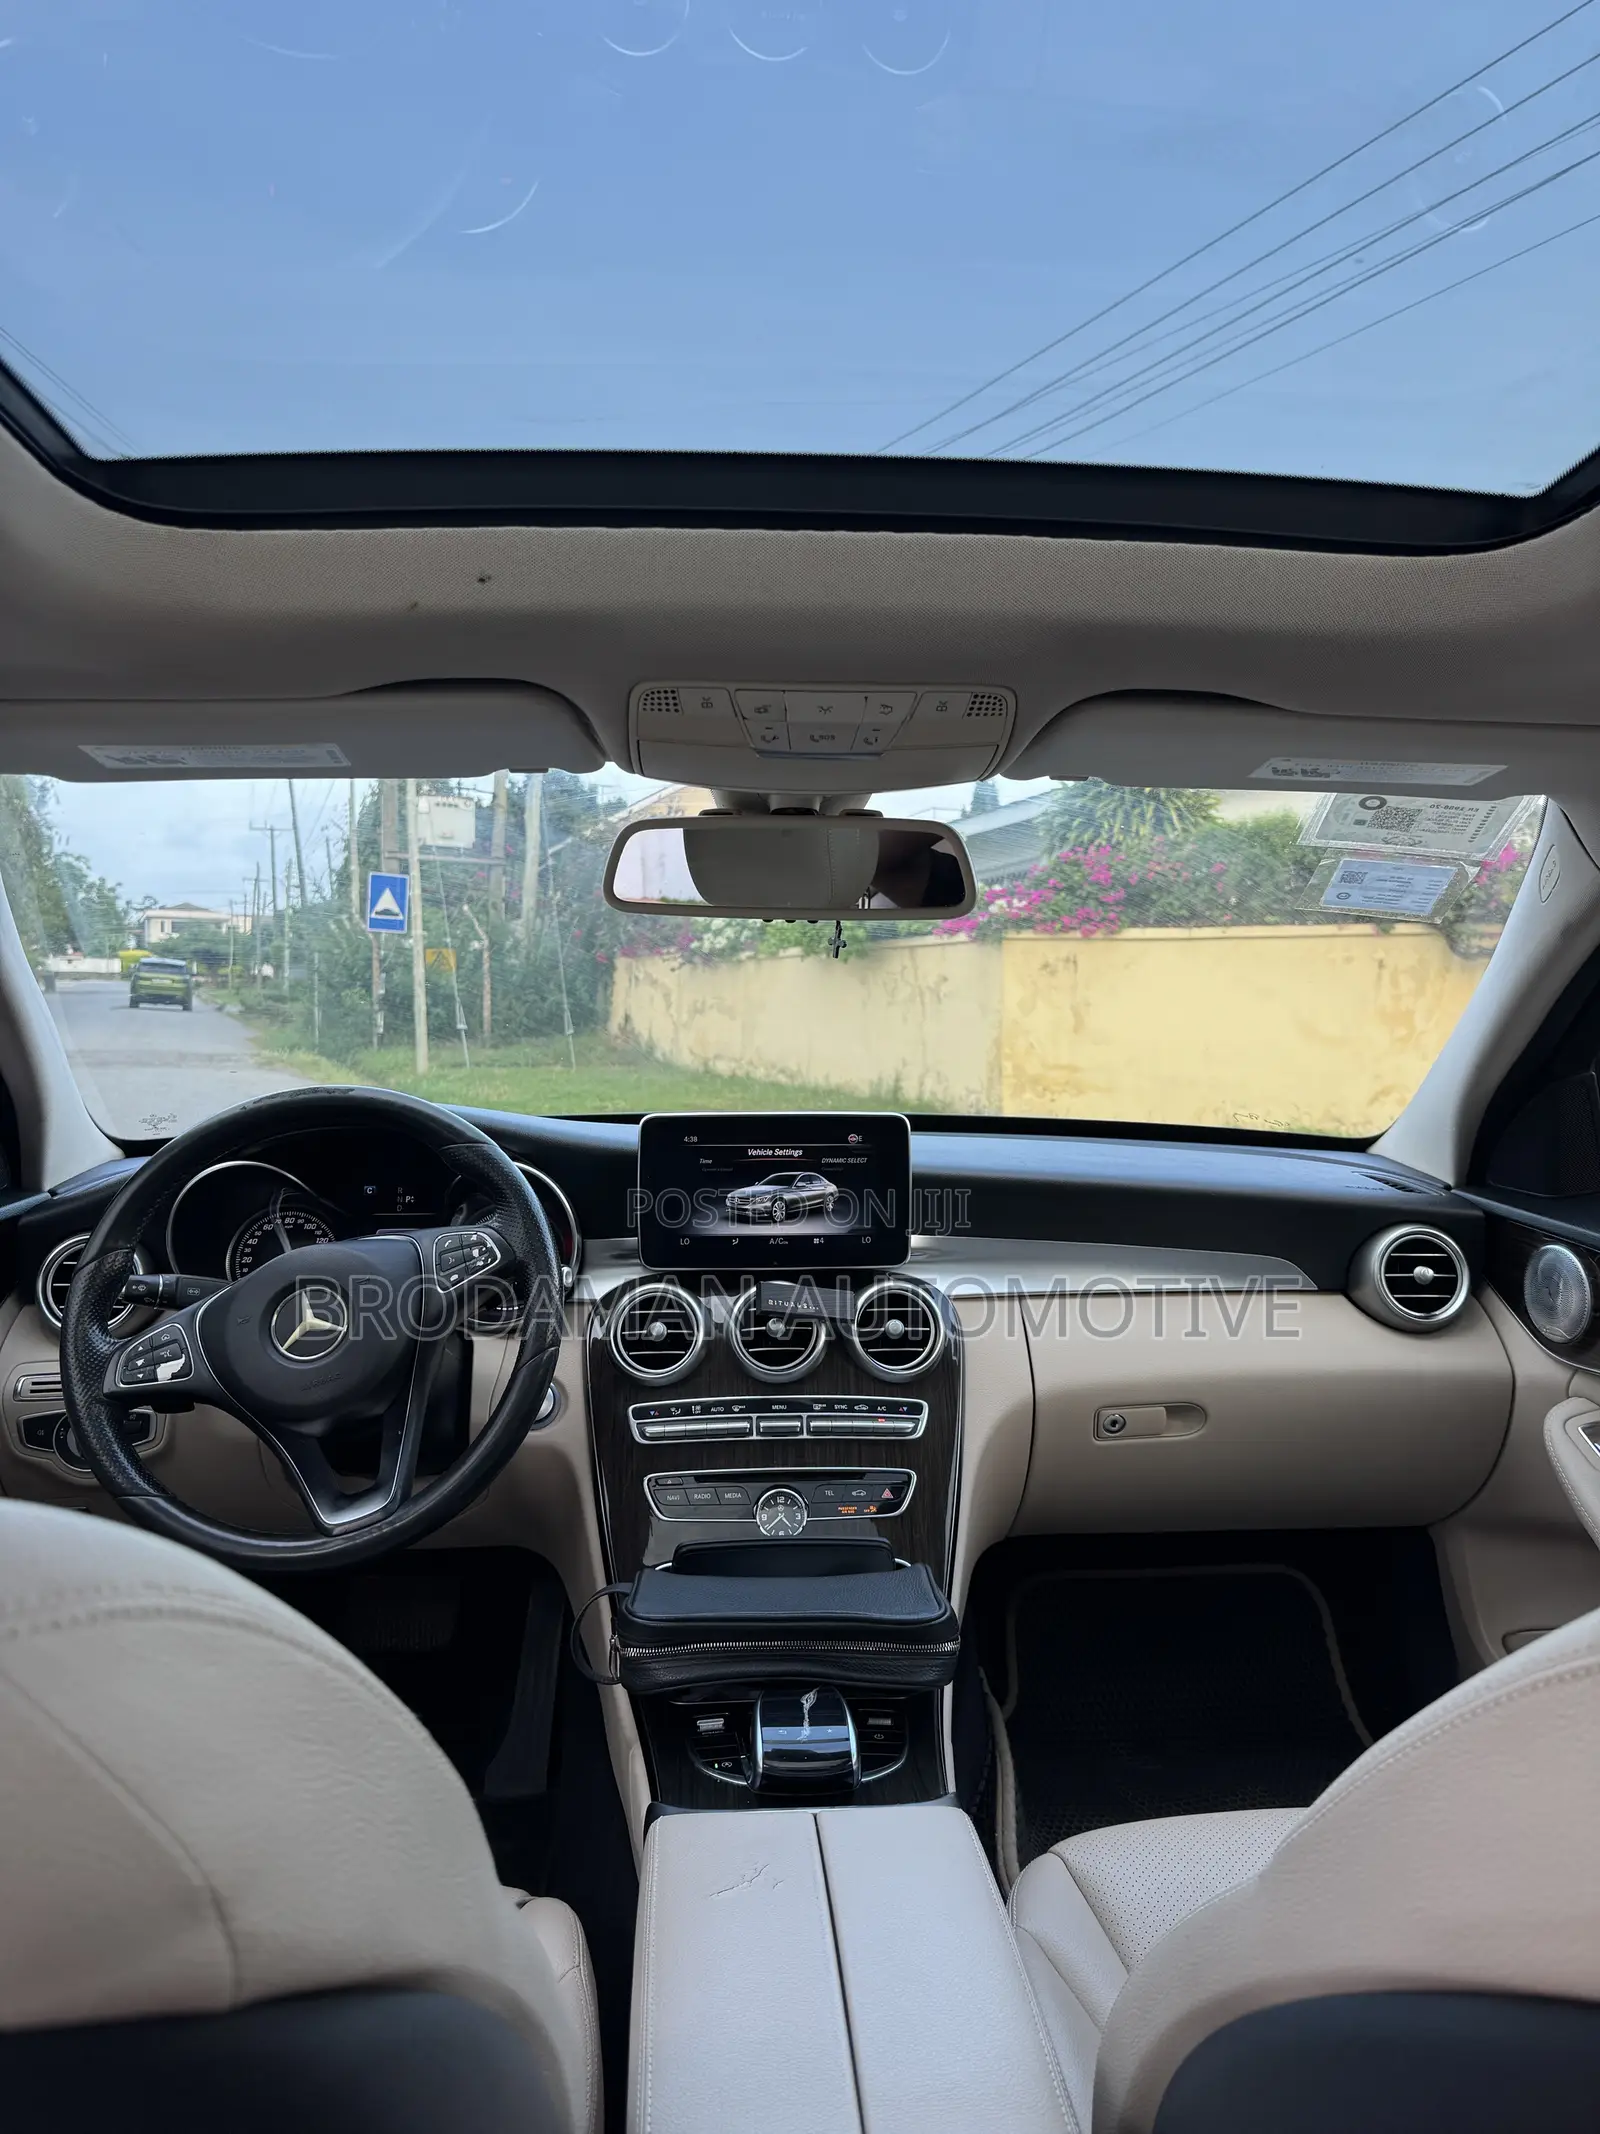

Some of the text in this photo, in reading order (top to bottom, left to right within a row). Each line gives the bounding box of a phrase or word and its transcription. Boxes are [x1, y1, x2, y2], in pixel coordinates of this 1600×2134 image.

[683, 1135, 698, 1143] 4:38
[858, 1134, 863, 1142] E
[747, 1148, 803, 1157] Vehicle Settings
[680, 1237, 690, 1246] LO
[768, 1237, 783, 1245] A/C
[861, 1236, 872, 1244] LO
[761, 1513, 768, 1521] 9
